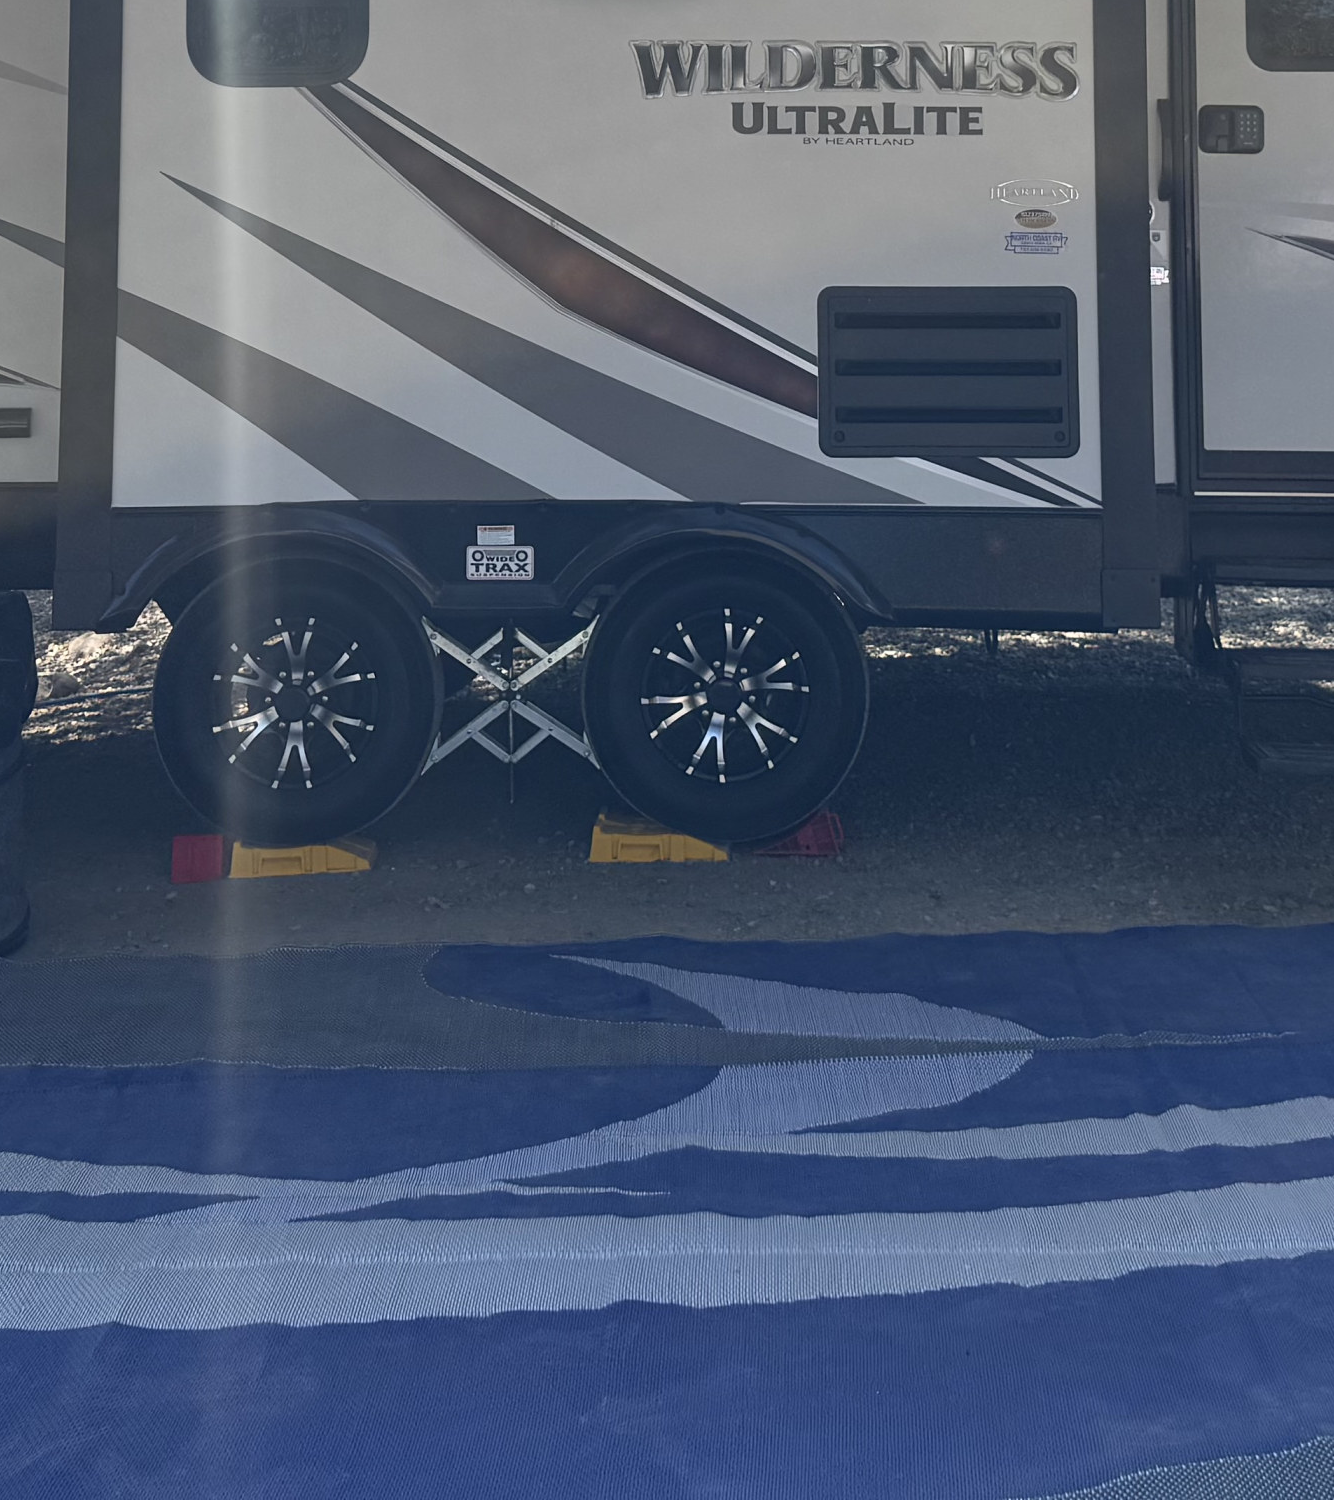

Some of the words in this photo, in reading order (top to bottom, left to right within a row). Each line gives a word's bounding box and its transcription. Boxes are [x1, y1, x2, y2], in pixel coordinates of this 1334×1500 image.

[629, 39, 1081, 102] WILDERNESS
[802, 136, 819, 145] BY
[825, 136, 915, 146] HEARTLAND
[990, 187, 1080, 200] HEARTLAND
[470, 562, 530, 573] TRAX
